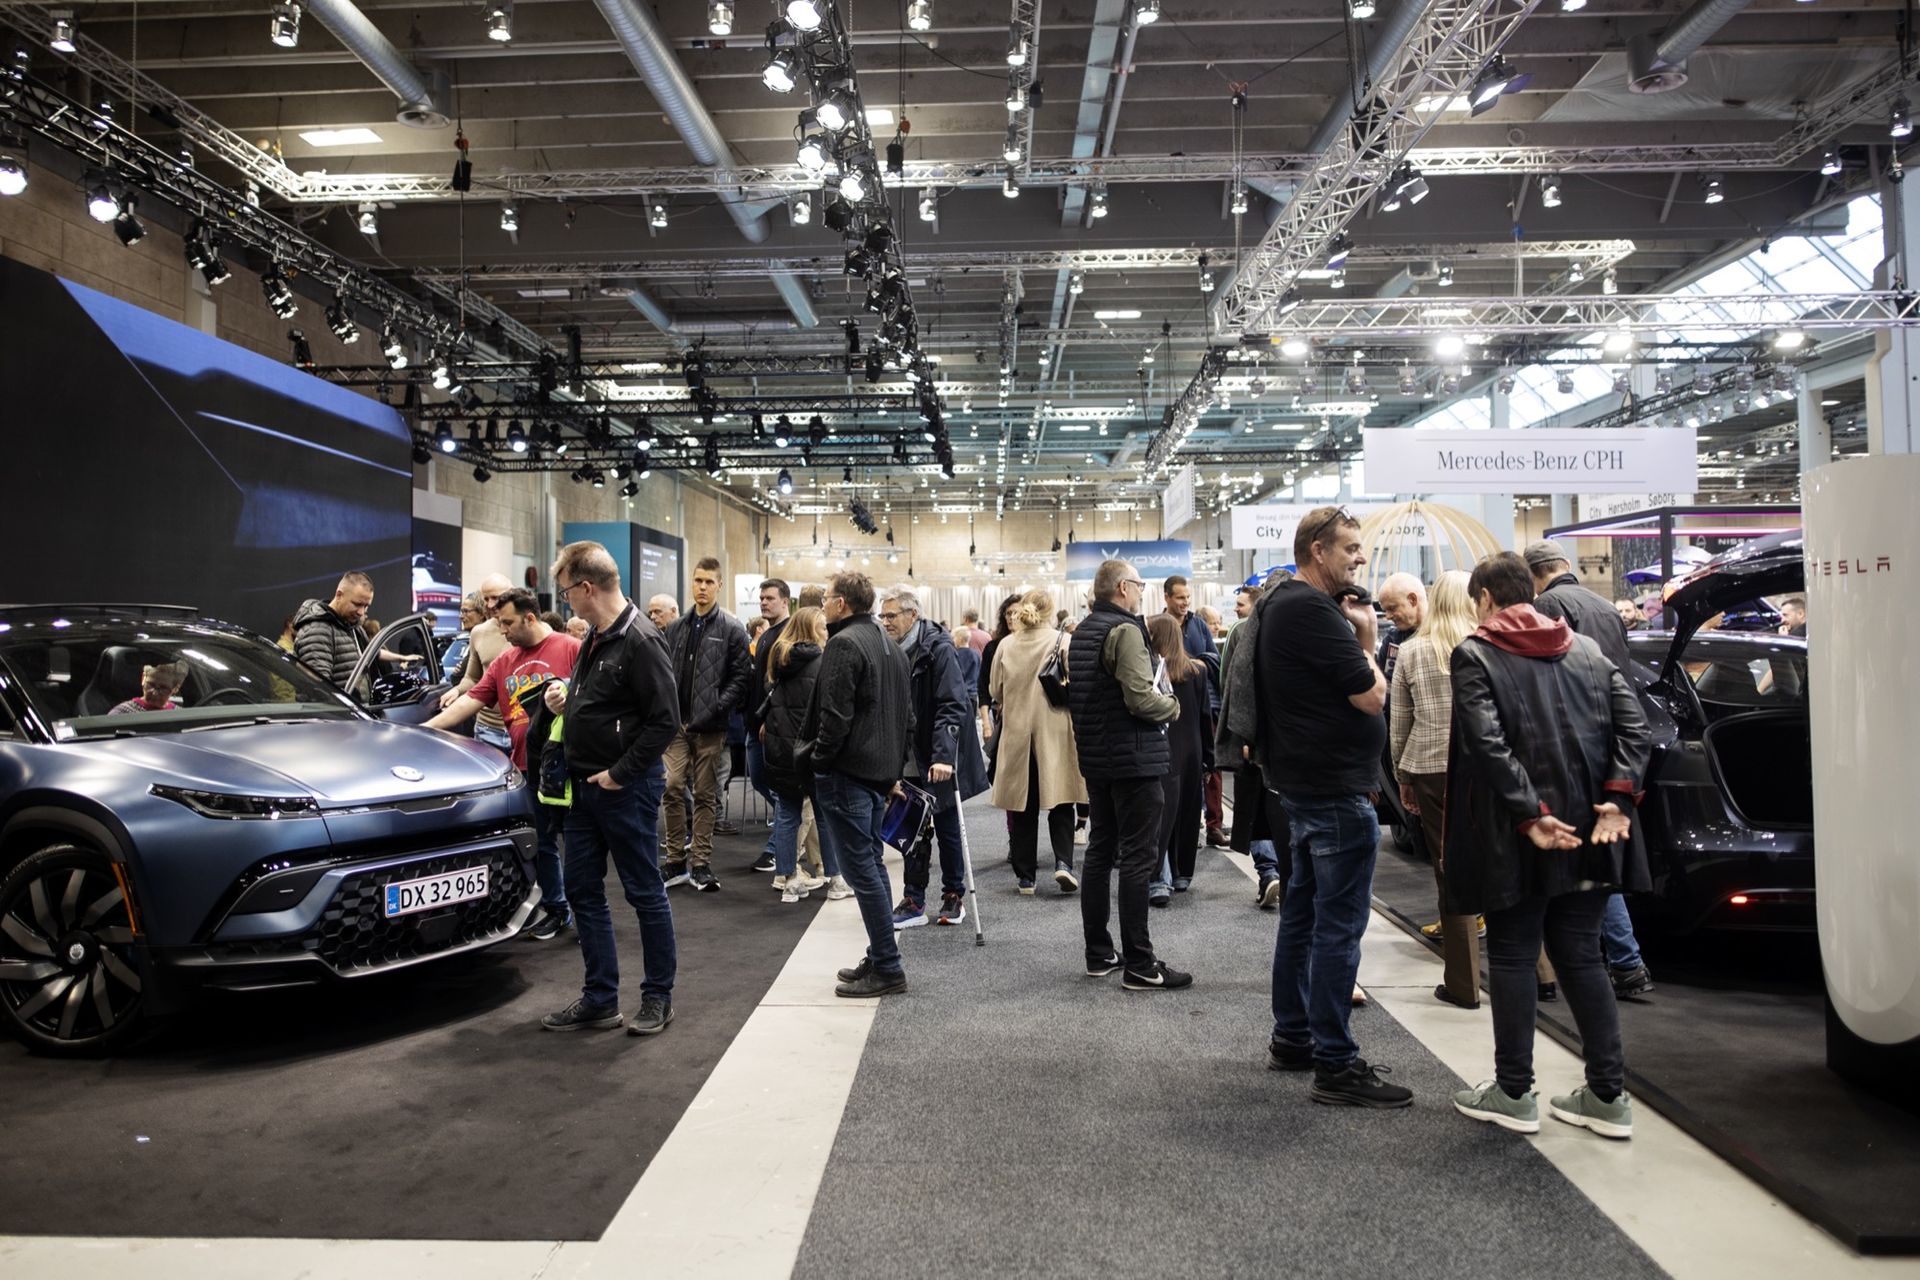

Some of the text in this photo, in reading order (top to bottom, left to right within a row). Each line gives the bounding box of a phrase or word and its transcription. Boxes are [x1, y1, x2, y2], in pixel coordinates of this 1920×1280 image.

[1437, 450, 1624, 471] Mercedes-Benz CPH
[1648, 492, 1676, 506] Søborg
[1256, 525, 1283, 540] City
[1718, 537, 1750, 546] NISS
[1121, 555, 1179, 565] VOYAH
[1812, 557, 1890, 576] TESLA
[401, 872, 486, 909] DX 32 965
